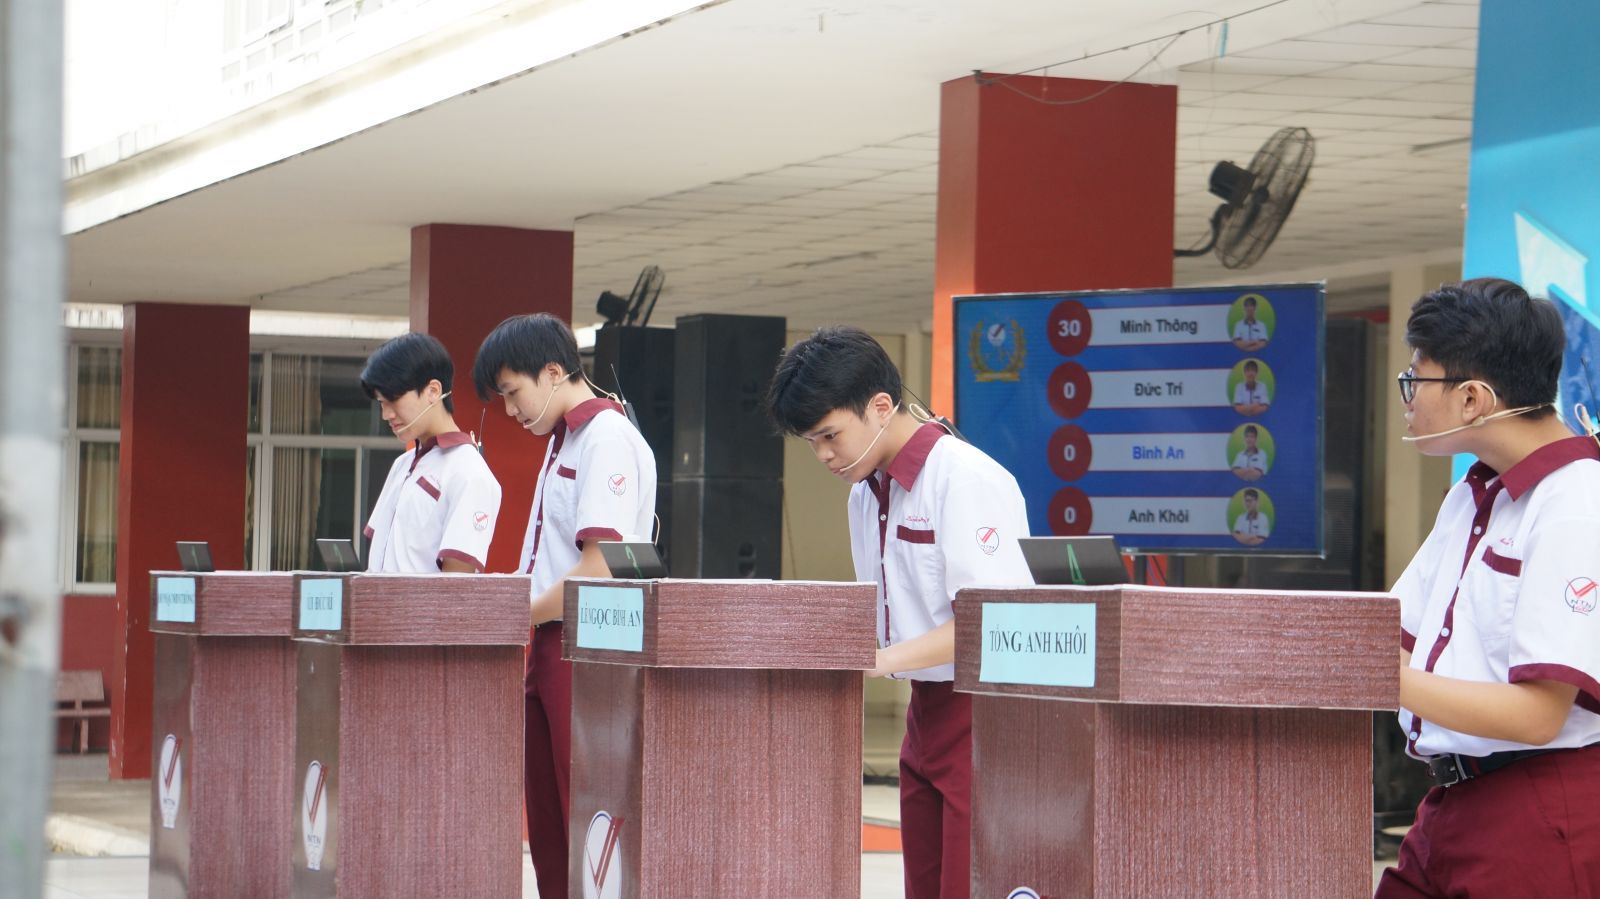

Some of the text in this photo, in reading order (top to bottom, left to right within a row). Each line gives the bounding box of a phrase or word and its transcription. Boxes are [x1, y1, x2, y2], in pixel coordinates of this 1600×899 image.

[1058, 319, 1082, 337] 30
[1120, 318, 1198, 335] Minh Thông
[1063, 381, 1076, 400] 0
[1134, 381, 1184, 397] Đức Trí
[1063, 444, 1076, 461] 0
[1166, 445, 1185, 460] An
[1063, 506, 1077, 524] 0
[1128, 509, 1190, 523] Anh Khôi
[627, 609, 641, 627] AN
[1025, 631, 1051, 653] ANH
[1055, 625, 1088, 655] KHÔI
